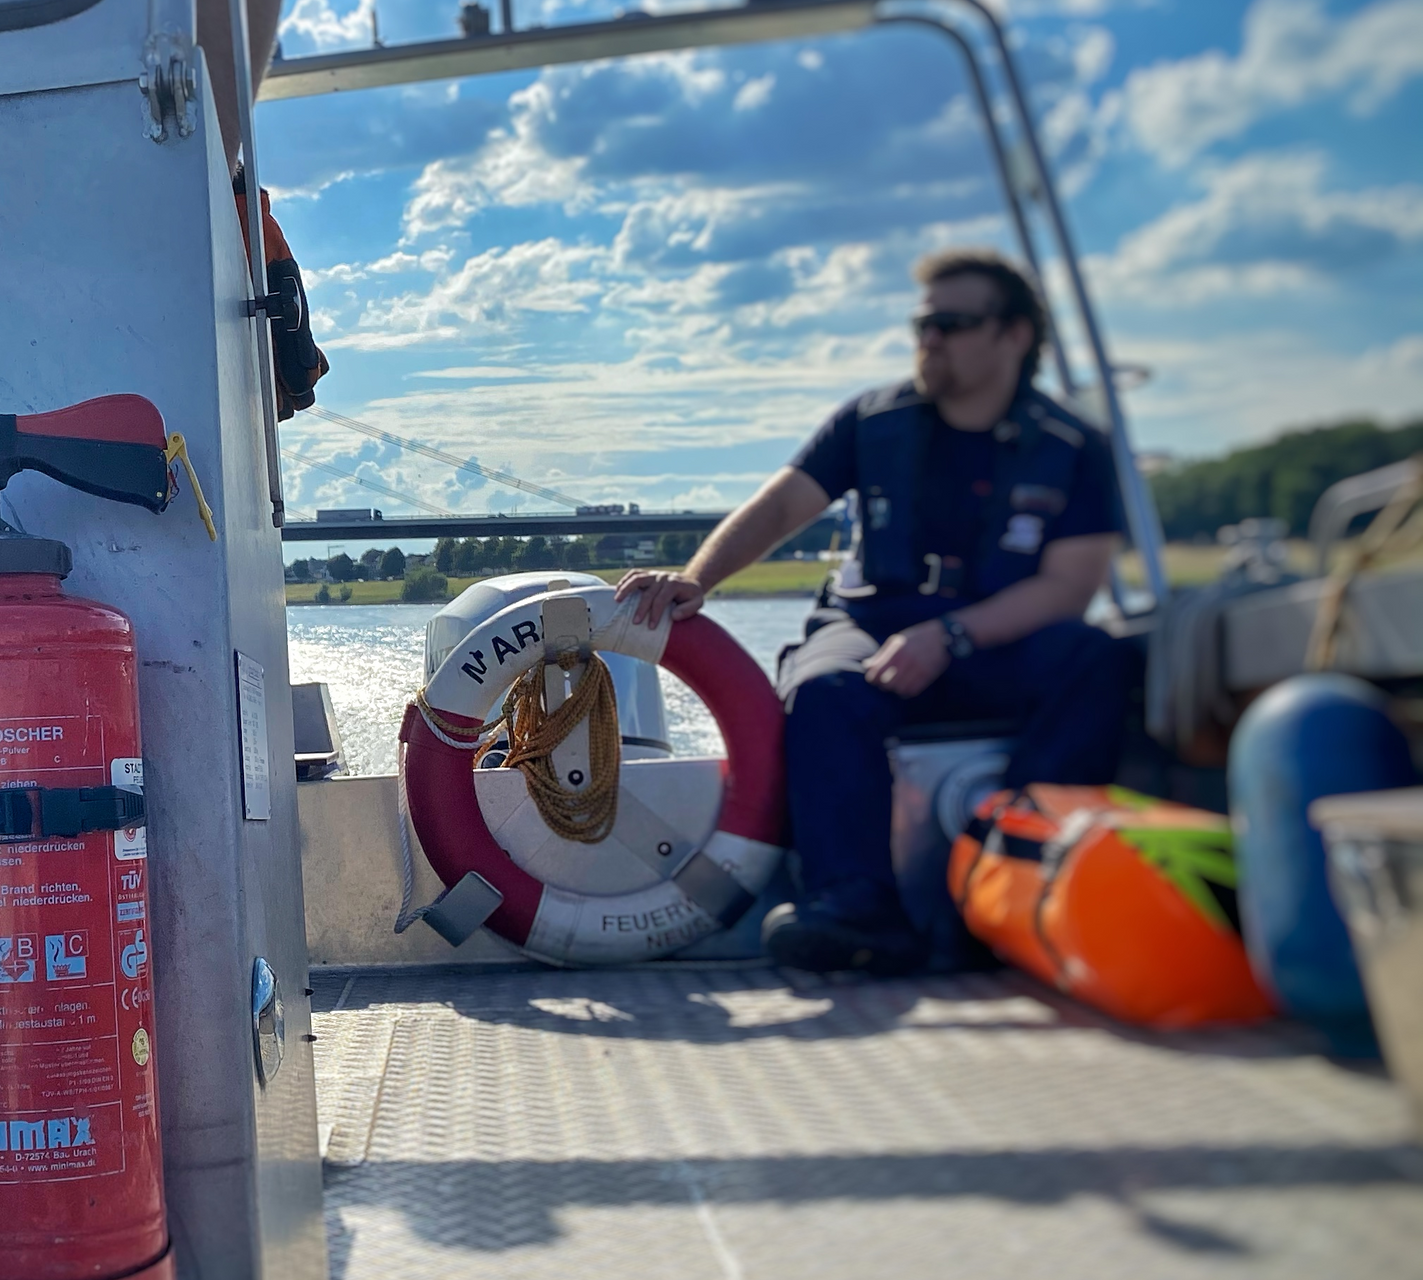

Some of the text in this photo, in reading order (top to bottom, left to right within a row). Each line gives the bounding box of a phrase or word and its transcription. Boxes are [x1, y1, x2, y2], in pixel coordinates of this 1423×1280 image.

[461, 615, 545, 685] MAR
[54, 755, 61, 764] C
[8, 842, 85, 855] niederdrücken
[121, 869, 143, 890] TÜV
[1, 884, 35, 895] Brand
[41, 882, 82, 894] richten,
[13, 893, 94, 907] niederdrücken.
[18, 939, 33, 957] B
[68, 935, 83, 955] C
[54, 1002, 91, 1014] nlagen.
[86, 1015, 96, 1024] m
[15, 1152, 51, 1162] D-72574
[73, 1147, 97, 1158] Urach
